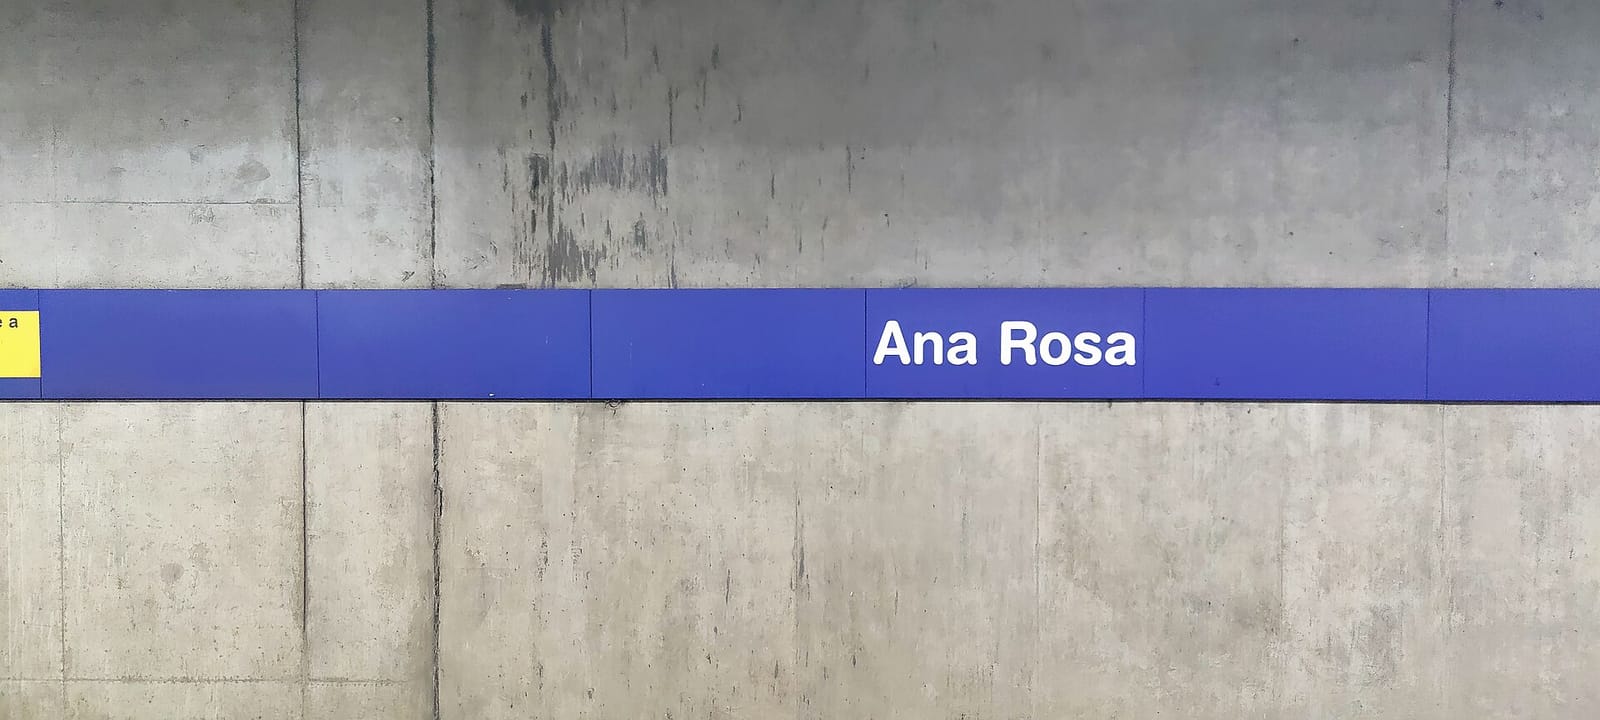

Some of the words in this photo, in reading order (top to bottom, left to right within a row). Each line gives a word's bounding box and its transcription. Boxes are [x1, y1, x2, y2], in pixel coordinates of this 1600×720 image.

[9, 317, 18, 328] a
[873, 320, 977, 365] Ana
[1000, 320, 1136, 366] Rosa
